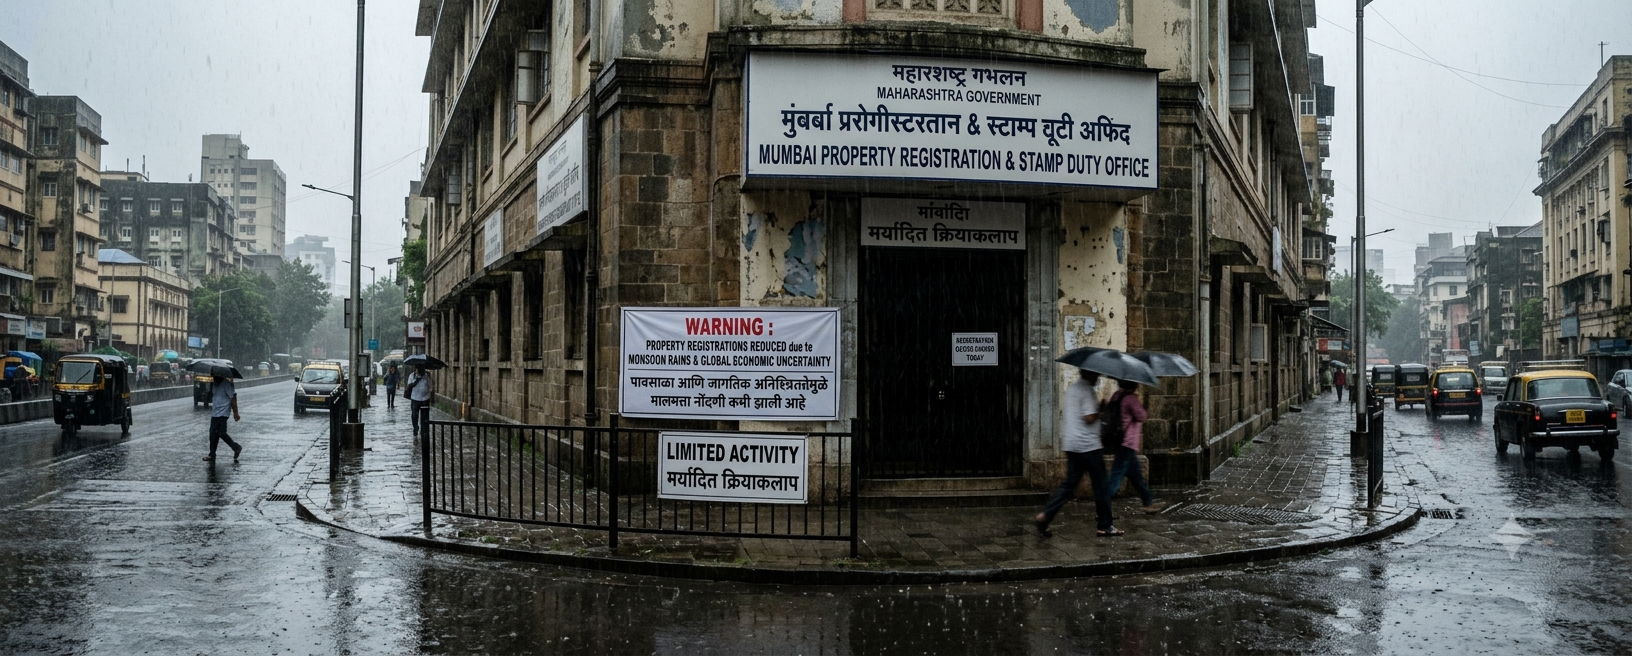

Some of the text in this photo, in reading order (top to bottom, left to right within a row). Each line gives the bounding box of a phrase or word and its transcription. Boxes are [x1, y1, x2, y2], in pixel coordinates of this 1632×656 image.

[972, 68, 1027, 86] गभलन
[877, 86, 1041, 106] MAHARASHTRA GOVERNMENT
[967, 113, 981, 136] &
[986, 116, 1037, 138] स्टाम्प
[759, 144, 1149, 178] MUMBAI PROPERTY REGISTRATION & STAMP DUTY OFFICE
[868, 222, 1019, 244] मर्यादित क्रियाकलाप
[685, 317, 763, 336] WARNING
[646, 340, 685, 351] PROPERTY
[687, 340, 748, 352] REGISTRATIONS
[750, 341, 787, 352] REDUCED
[789, 341, 803, 352] due
[628, 354, 667, 365] MONSOON
[668, 355, 691, 366] RAINS
[693, 355, 699, 366] &
[701, 355, 731, 366] GLOBAL
[776, 356, 831, 367] UNCERTAINTY
[630, 377, 675, 388] पावसाळा
[678, 374, 705, 389] आणि
[785, 394, 806, 410] आहे
[667, 442, 799, 464] LIMITED ACTIVITY
[667, 467, 799, 491] मर्यादित क्रियाकलाप
